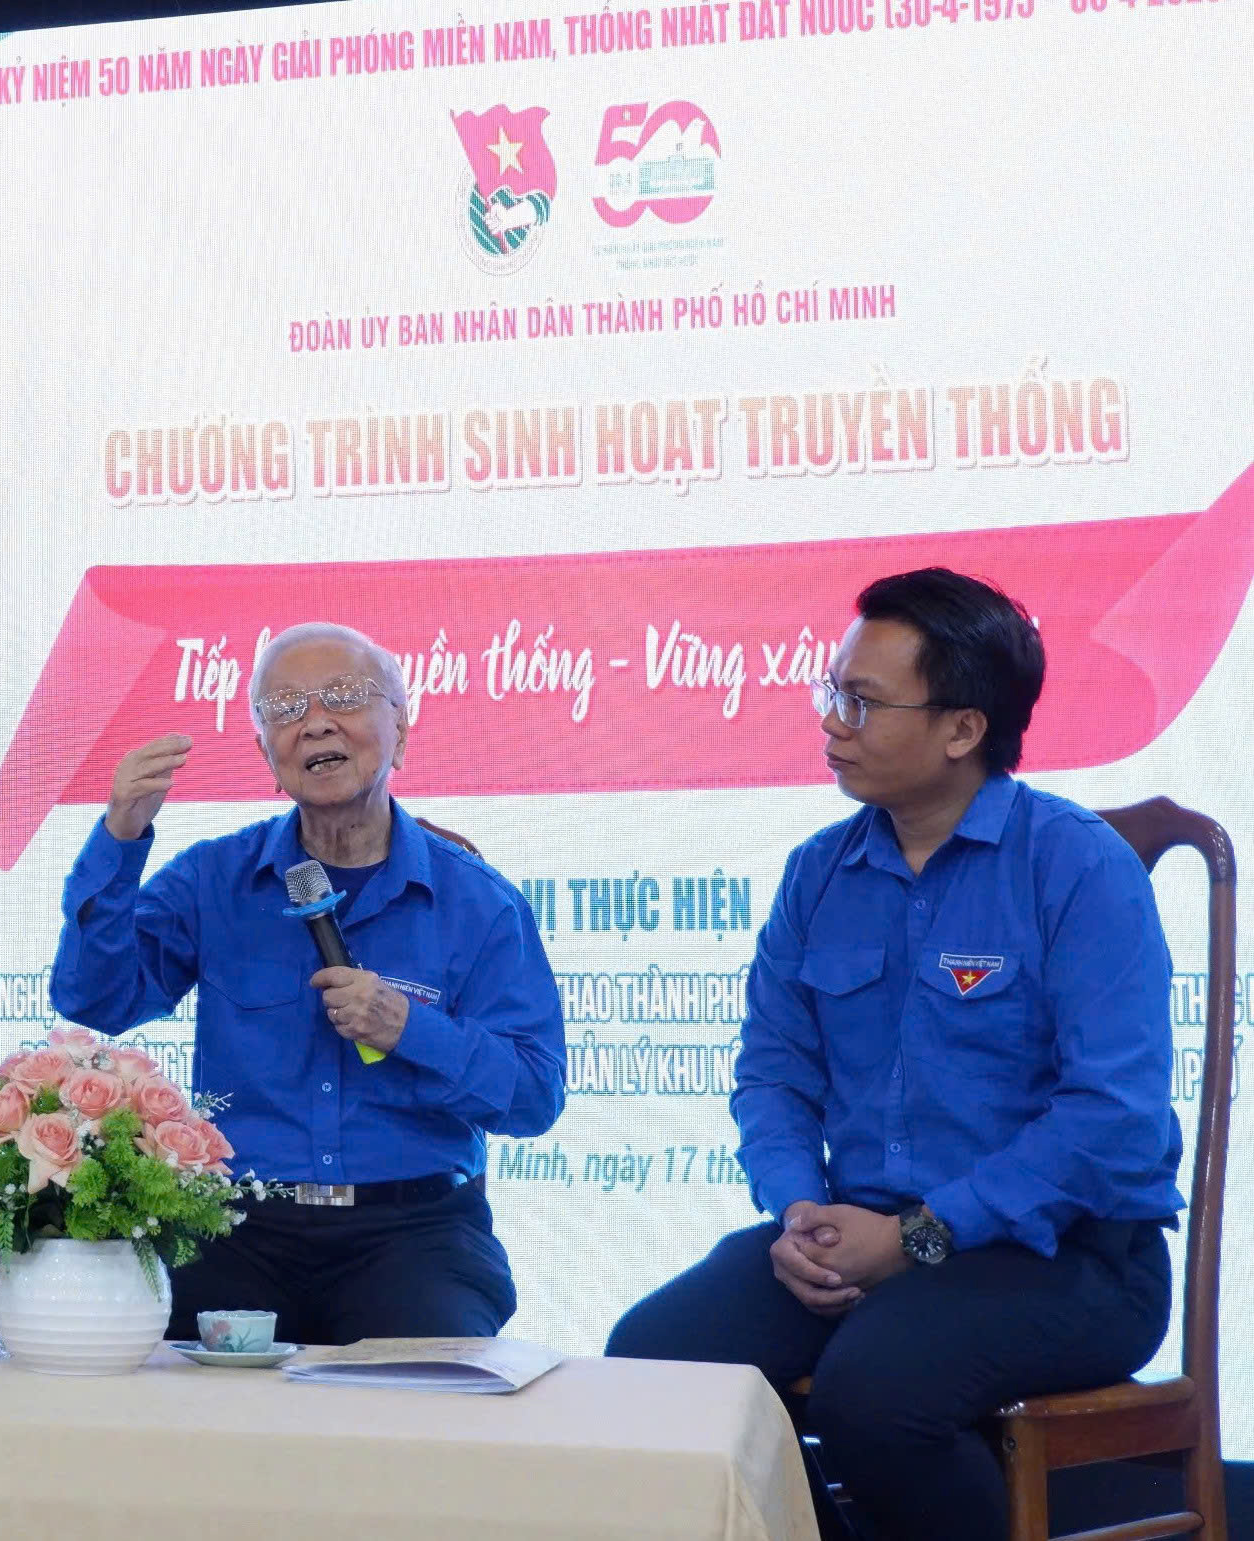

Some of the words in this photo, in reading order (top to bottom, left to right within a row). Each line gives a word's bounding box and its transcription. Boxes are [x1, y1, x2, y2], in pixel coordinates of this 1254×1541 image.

[33, 55, 91, 108] NIỆM
[99, 56, 130, 96] 50
[138, 46, 192, 93] NĂM
[201, 39, 264, 88] NGÀY
[272, 30, 322, 82] GIẢI
[330, 27, 415, 76] PHÓNG
[423, 13, 485, 68] MIỀN
[494, 18, 556, 62] NAM,
[563, 0, 653, 55] THỐNG
[288, 311, 351, 352] ĐOÀN
[361, 306, 390, 349] ỦY
[398, 312, 444, 347] BAN
[454, 301, 518, 343] NHÂN
[527, 297, 575, 339] DÂN
[582, 292, 664, 335] THÀNH
[673, 282, 724, 330] PHỐ
[733, 280, 767, 326] HỒ
[776, 280, 820, 324] CHÍ
[829, 284, 896, 321] MINH
[104, 412, 292, 500] CHƯƠNG
[305, 405, 447, 489] TRÌNH
[463, 406, 577, 483] SINH
[594, 398, 723, 488] HOẠT
[739, 361, 929, 467] TRUYỀN
[948, 352, 1123, 458] THỐNG
[174, 633, 242, 733] Tiếp
[481, 618, 596, 723] thống
[646, 619, 746, 720] Vững
[567, 870, 660, 942] THỰC
[673, 867, 752, 942] HIỆN
[614, 964, 702, 1023] THÀNH
[565, 1029, 617, 1094] UẢN
[619, 1035, 653, 1094] LÝ
[655, 1043, 709, 1094] KHU
[498, 1142, 574, 1189] Minh,
[583, 1144, 653, 1192] ngày
[664, 1145, 698, 1183] 17
